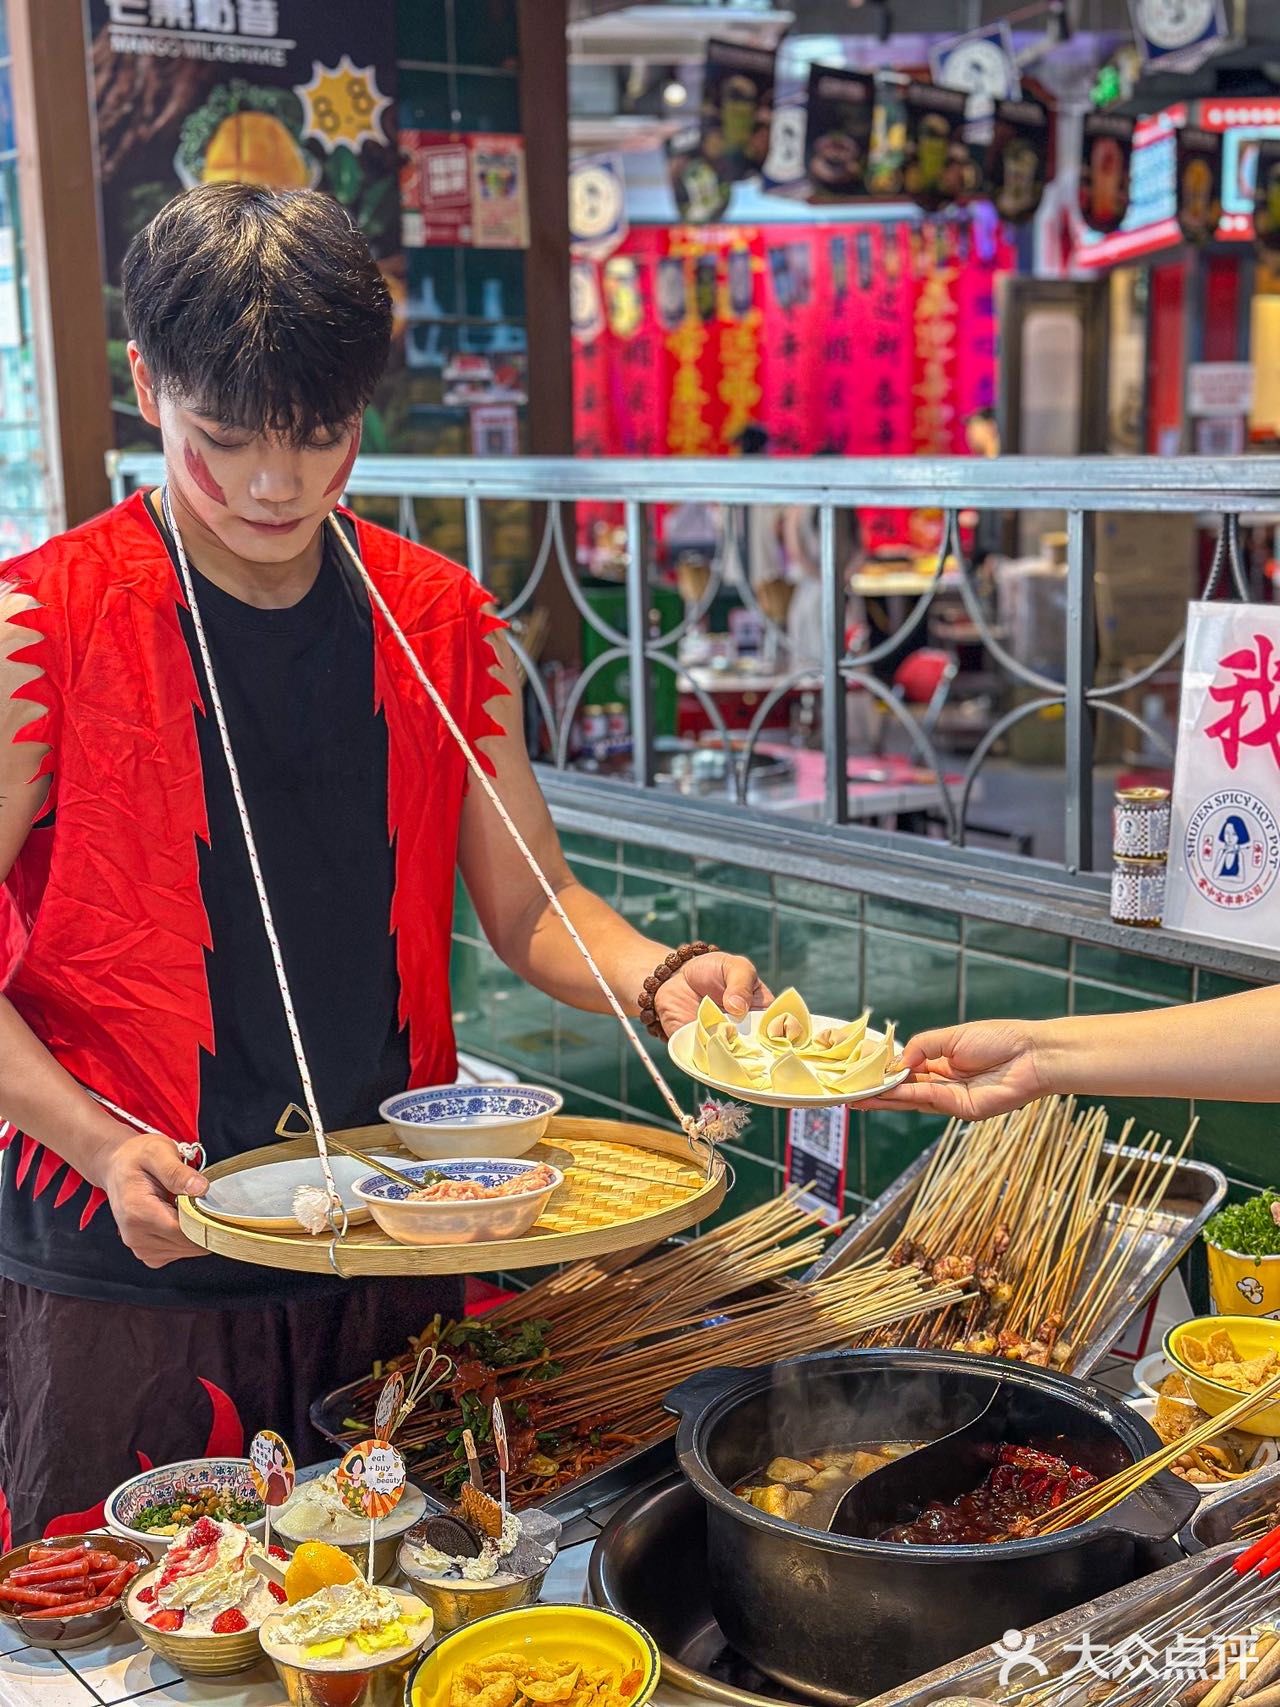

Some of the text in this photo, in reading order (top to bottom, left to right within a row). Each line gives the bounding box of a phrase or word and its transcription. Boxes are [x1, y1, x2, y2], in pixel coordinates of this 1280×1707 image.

[110, 34, 288, 67] MANGO MILKSHAKE
[1187, 801, 1214, 859] SHUFEN
[1214, 793, 1252, 807] SPICY
[1251, 801, 1275, 831] HOT
[1269, 834, 1280, 869] POT
